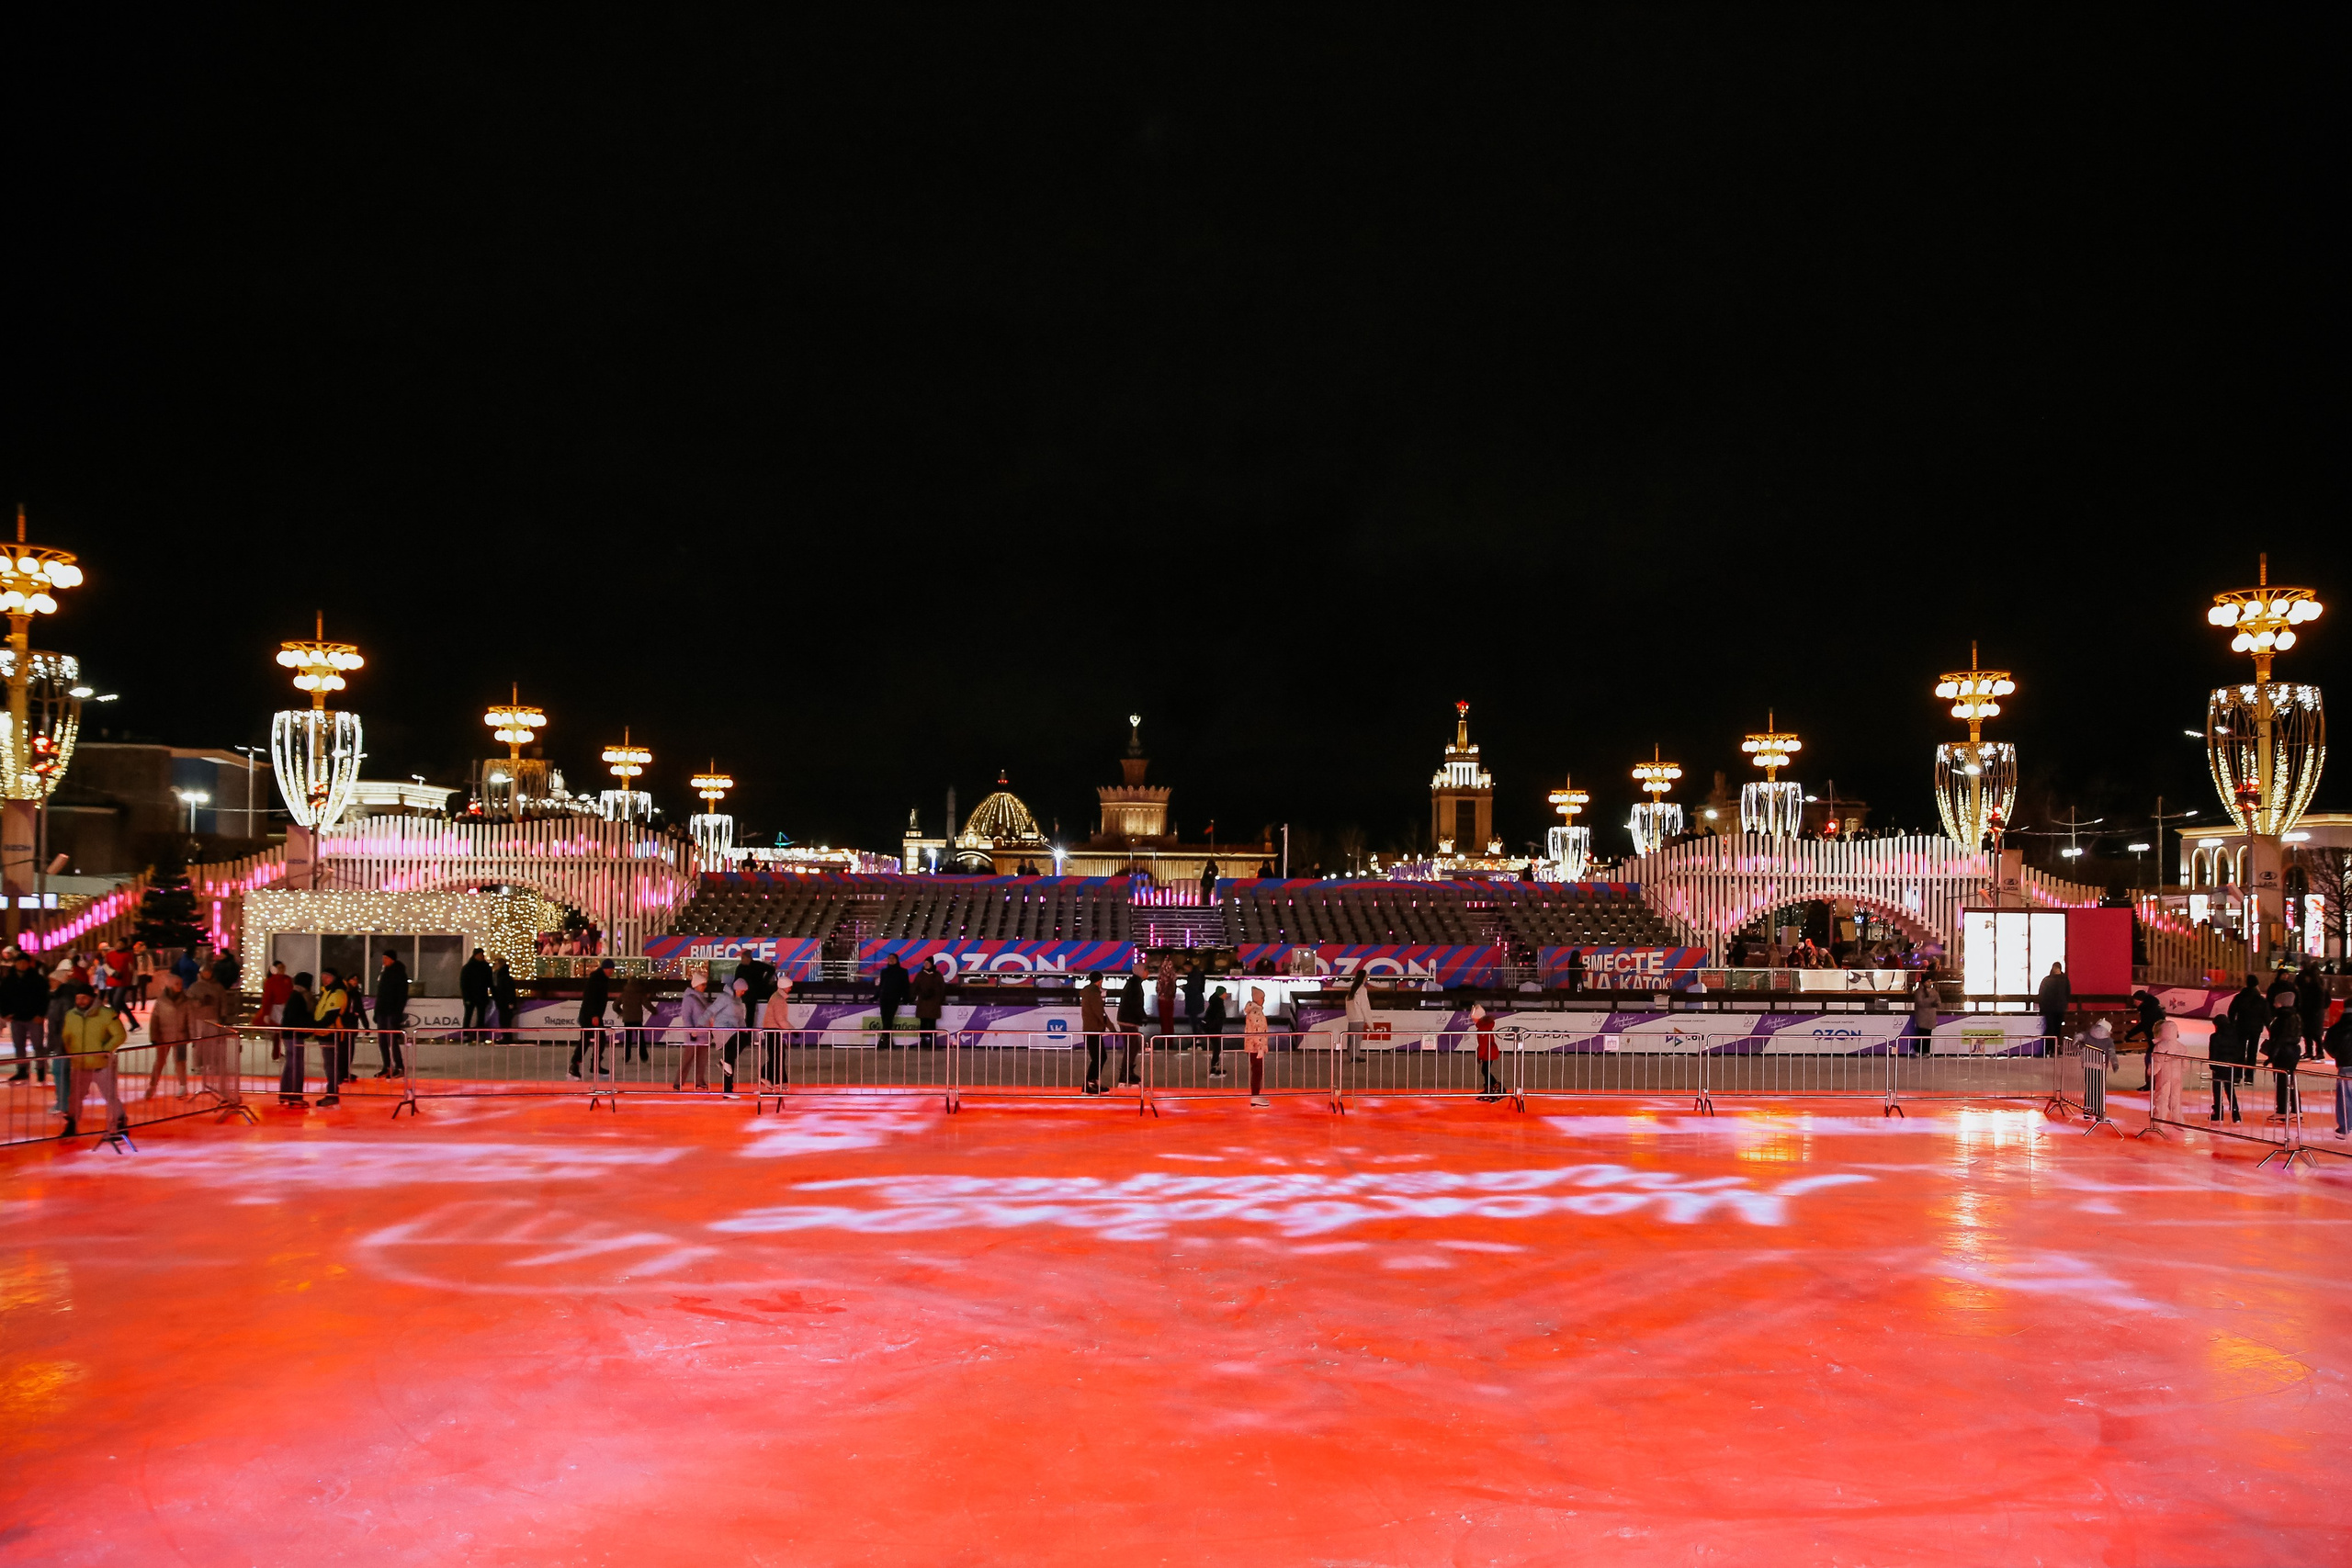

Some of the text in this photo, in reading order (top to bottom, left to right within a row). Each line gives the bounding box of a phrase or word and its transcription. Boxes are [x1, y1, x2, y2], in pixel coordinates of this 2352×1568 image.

[1582, 952, 1664, 975] ВМЕСТЕ
[424, 1017, 460, 1025] LADA
[544, 1016, 575, 1025] Яндекс
[1812, 1029, 1861, 1041] OZON
